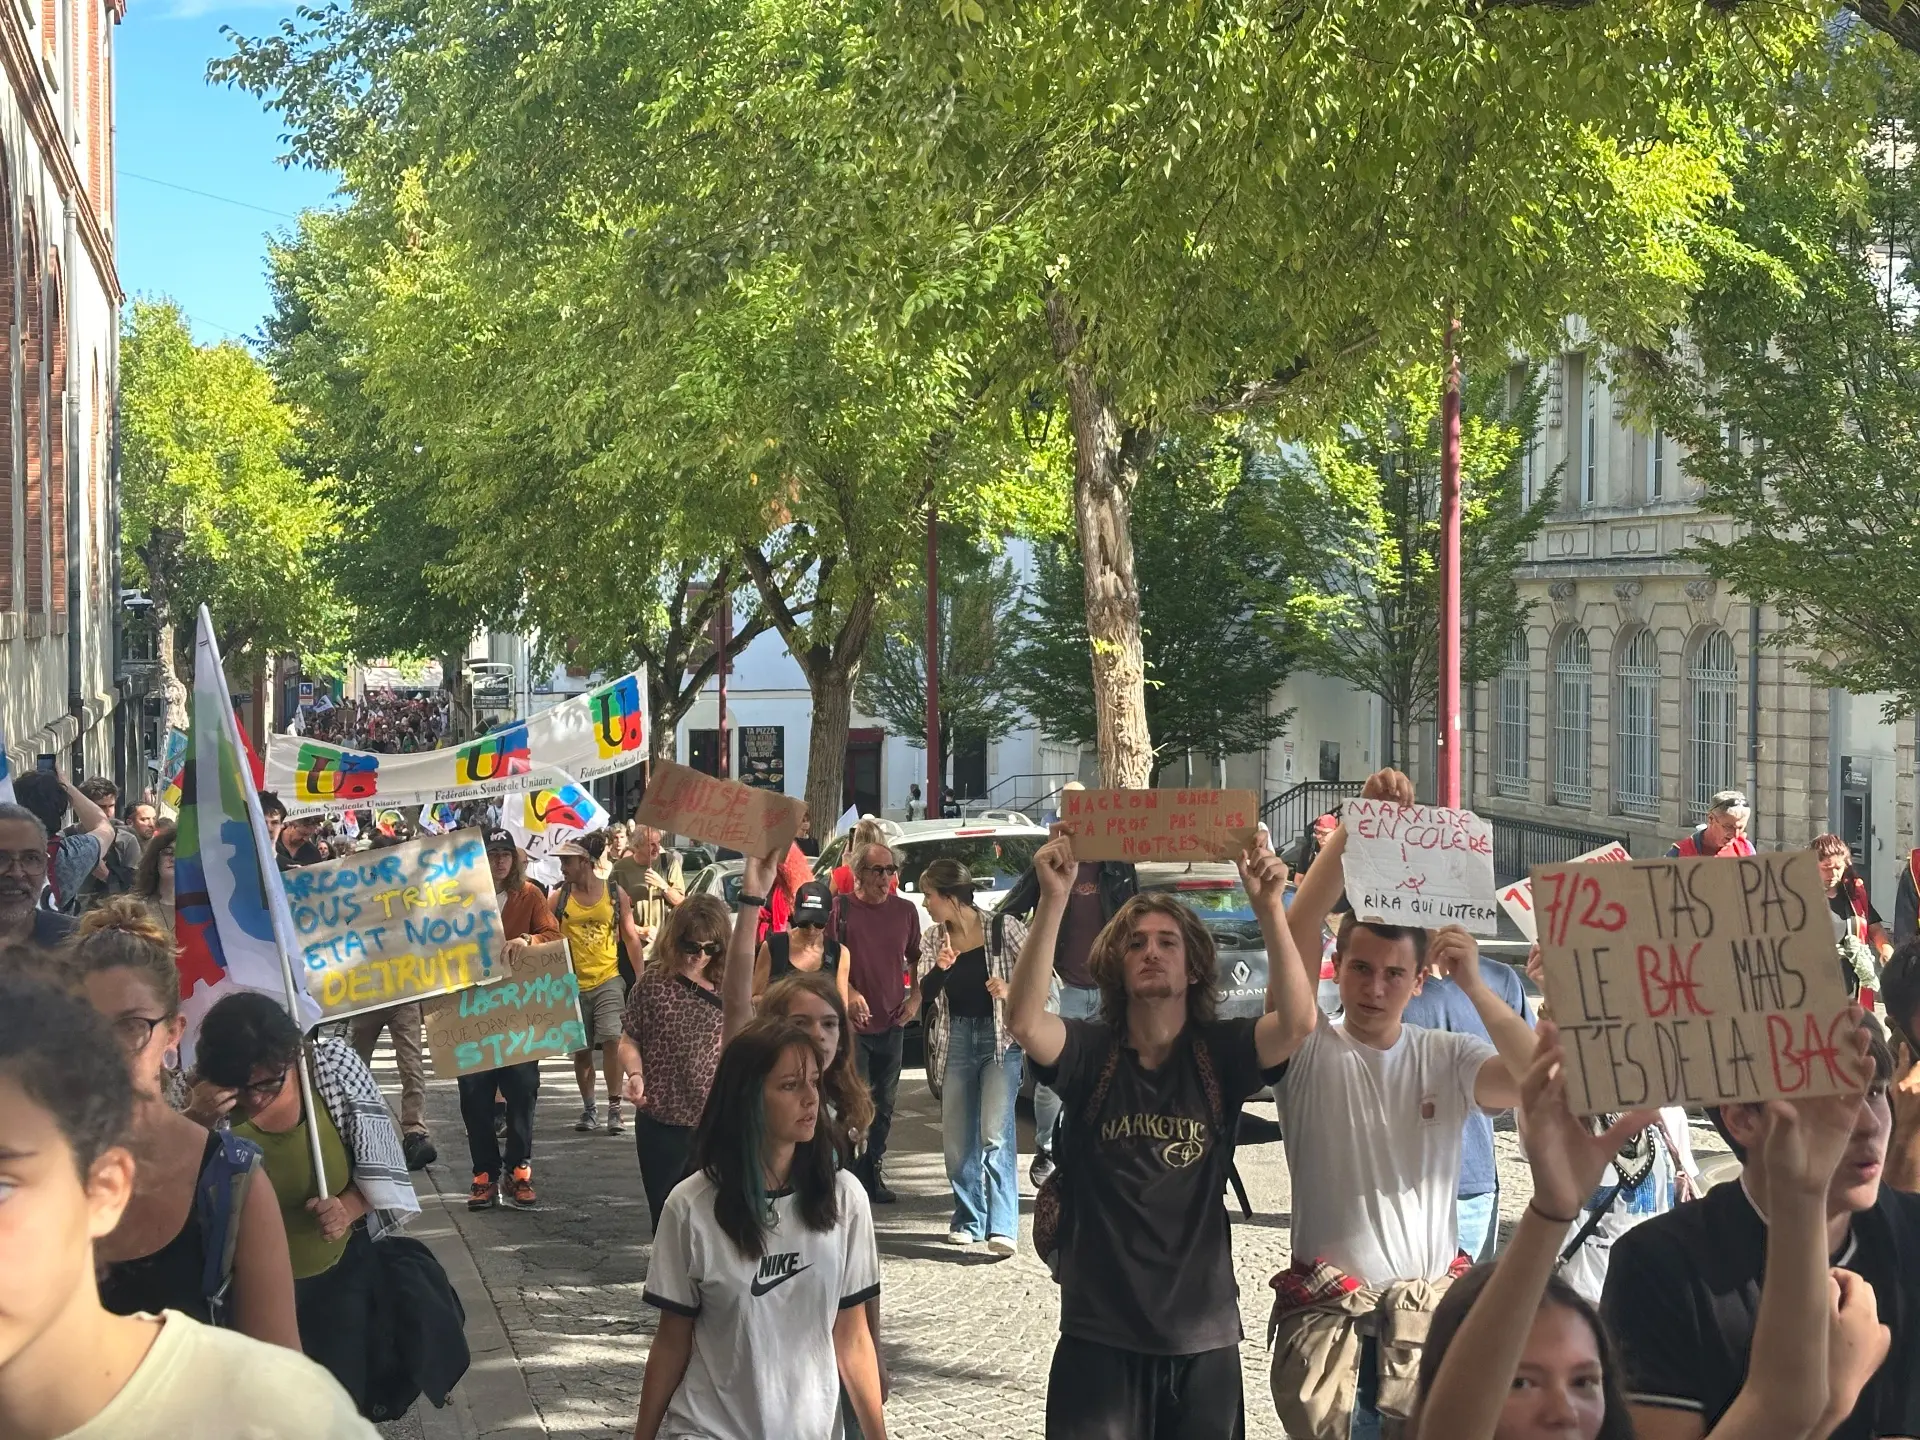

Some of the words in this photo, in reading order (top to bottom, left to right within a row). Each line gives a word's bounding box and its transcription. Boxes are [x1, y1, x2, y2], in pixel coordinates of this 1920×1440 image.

[434, 789, 478, 801] Fédération
[480, 782, 519, 796] Syndicale
[521, 776, 553, 789] Unitaire
[1068, 792, 1159, 816] MACRON
[1177, 792, 1220, 806] BAISE
[1348, 801, 1471, 833] MARXISTE
[1106, 816, 1149, 836] PROF
[1169, 813, 1197, 830] PAS
[1213, 812, 1245, 828] LES
[1358, 818, 1399, 840] EN
[282, 855, 408, 901] ARCOUR
[417, 839, 484, 882] SUP
[1440, 898, 1496, 920] LUTTERA
[1541, 872, 1628, 948] 7/20
[1633, 862, 1714, 940] T'AS
[1738, 857, 1807, 935] PAS
[404, 909, 497, 945] NOUS
[1574, 947, 1622, 1022] LE
[1636, 942, 1715, 1019] BAC
[1731, 936, 1807, 1013] MAIS
[432, 1026, 472, 1049] QUE
[453, 1020, 585, 1070] STYLOS
[1559, 1022, 1649, 1110] T'ES
[1653, 1020, 1703, 1102] DE
[1705, 1016, 1761, 1099] LA
[1766, 1010, 1862, 1093] BAC
[758, 1252, 800, 1279] NIKE
